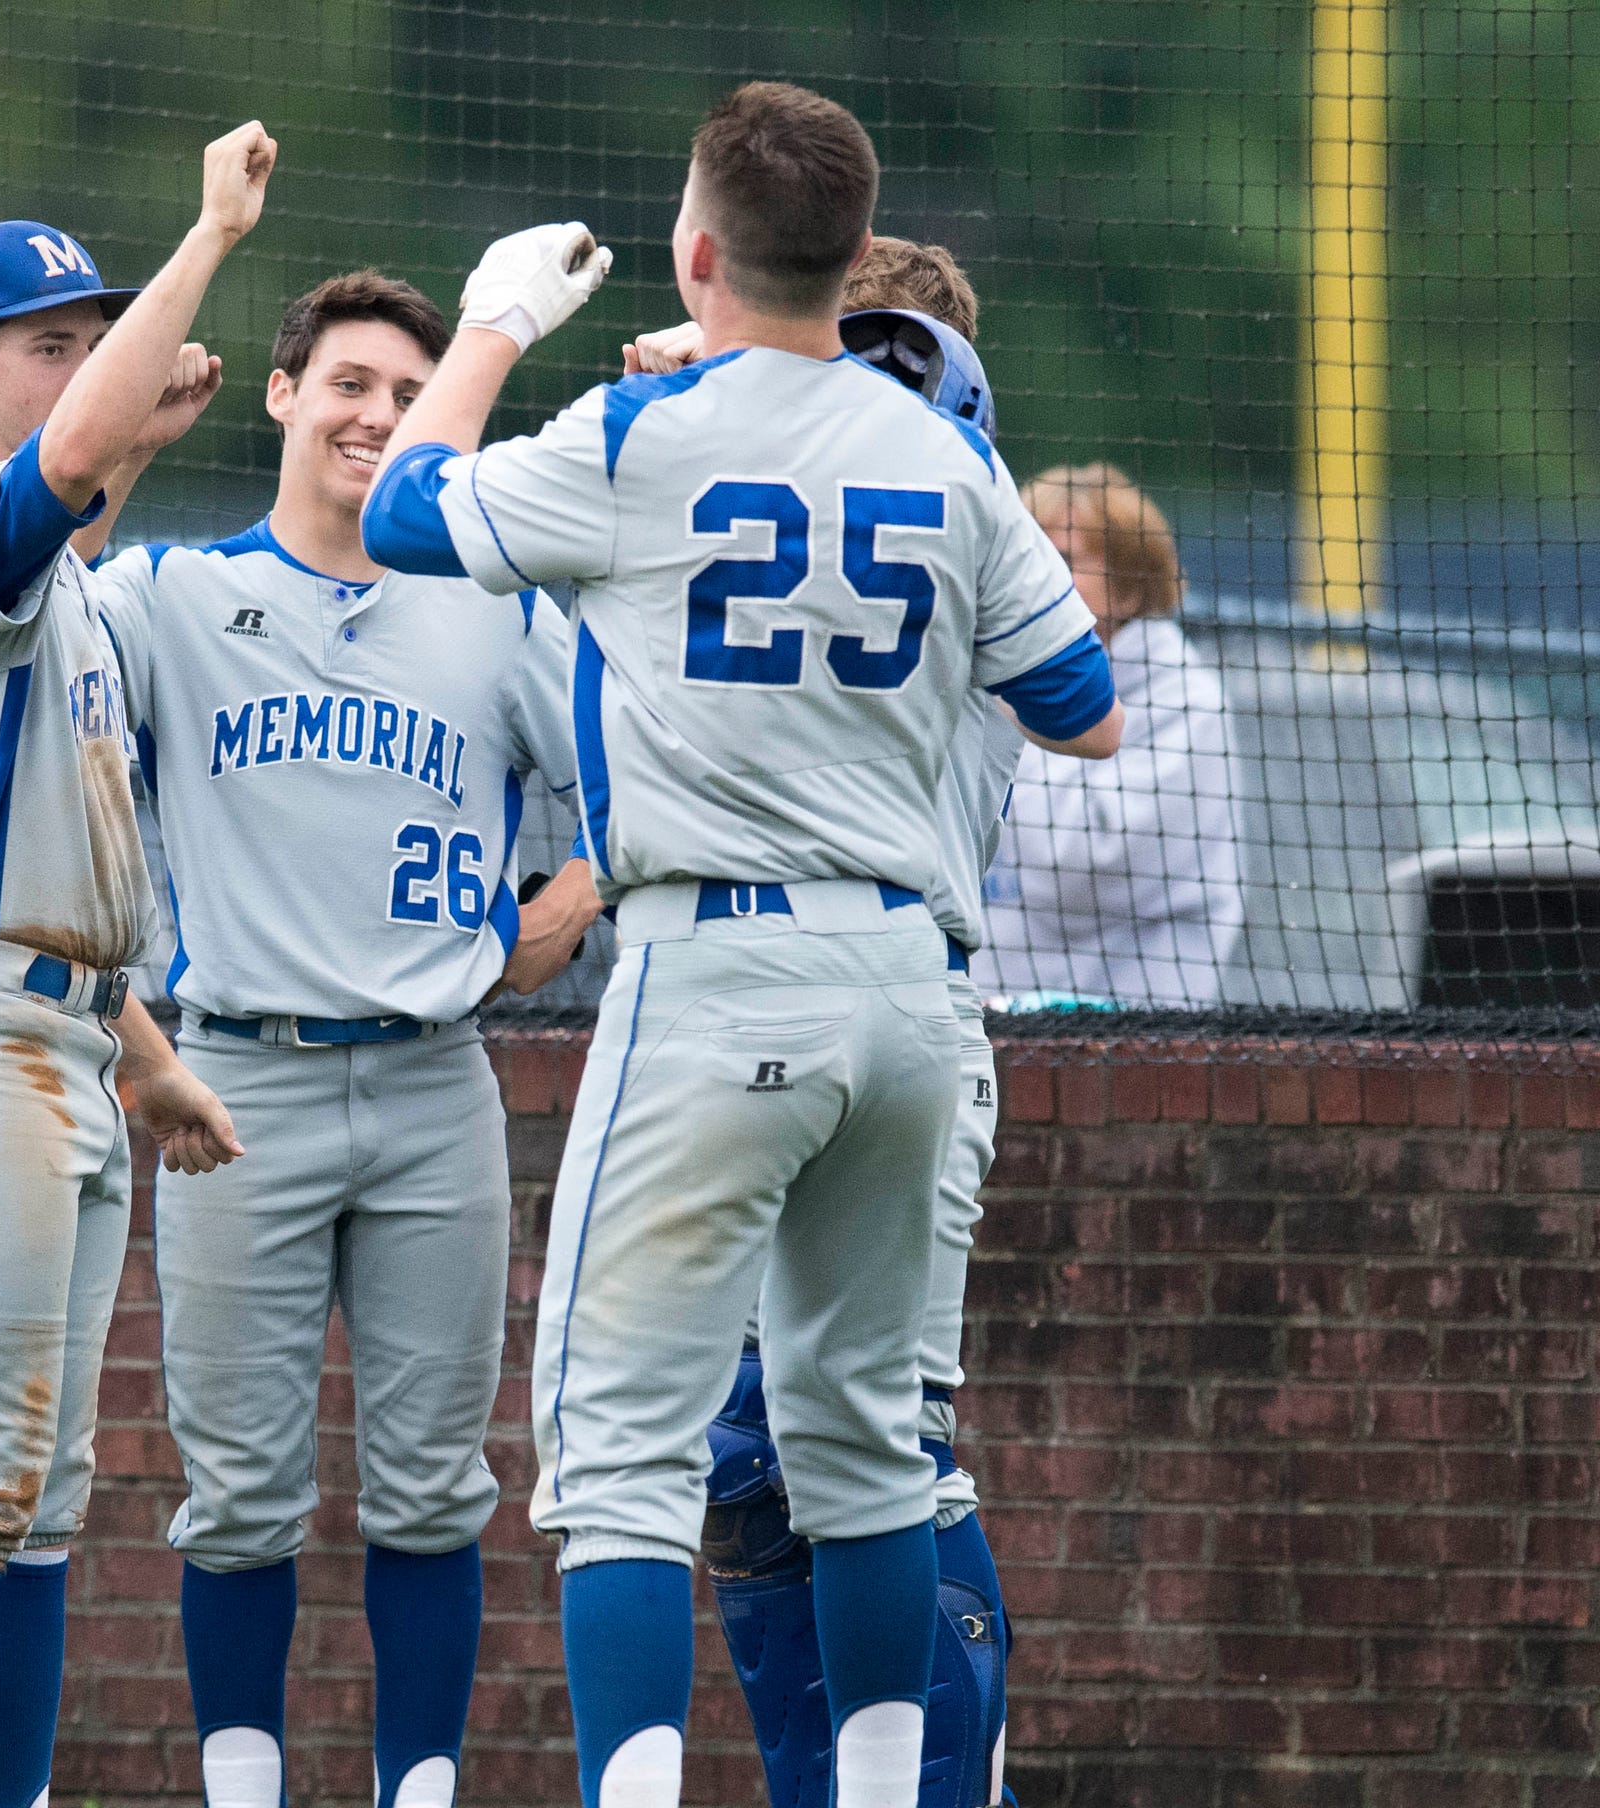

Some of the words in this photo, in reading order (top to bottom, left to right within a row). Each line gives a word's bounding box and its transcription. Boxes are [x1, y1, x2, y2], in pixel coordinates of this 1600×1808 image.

[26, 233, 94, 278] M
[224, 626, 270, 639] RUSSELL
[679, 474, 950, 692] 25
[208, 690, 468, 814] MEMORIAL
[385, 819, 487, 935] 26
